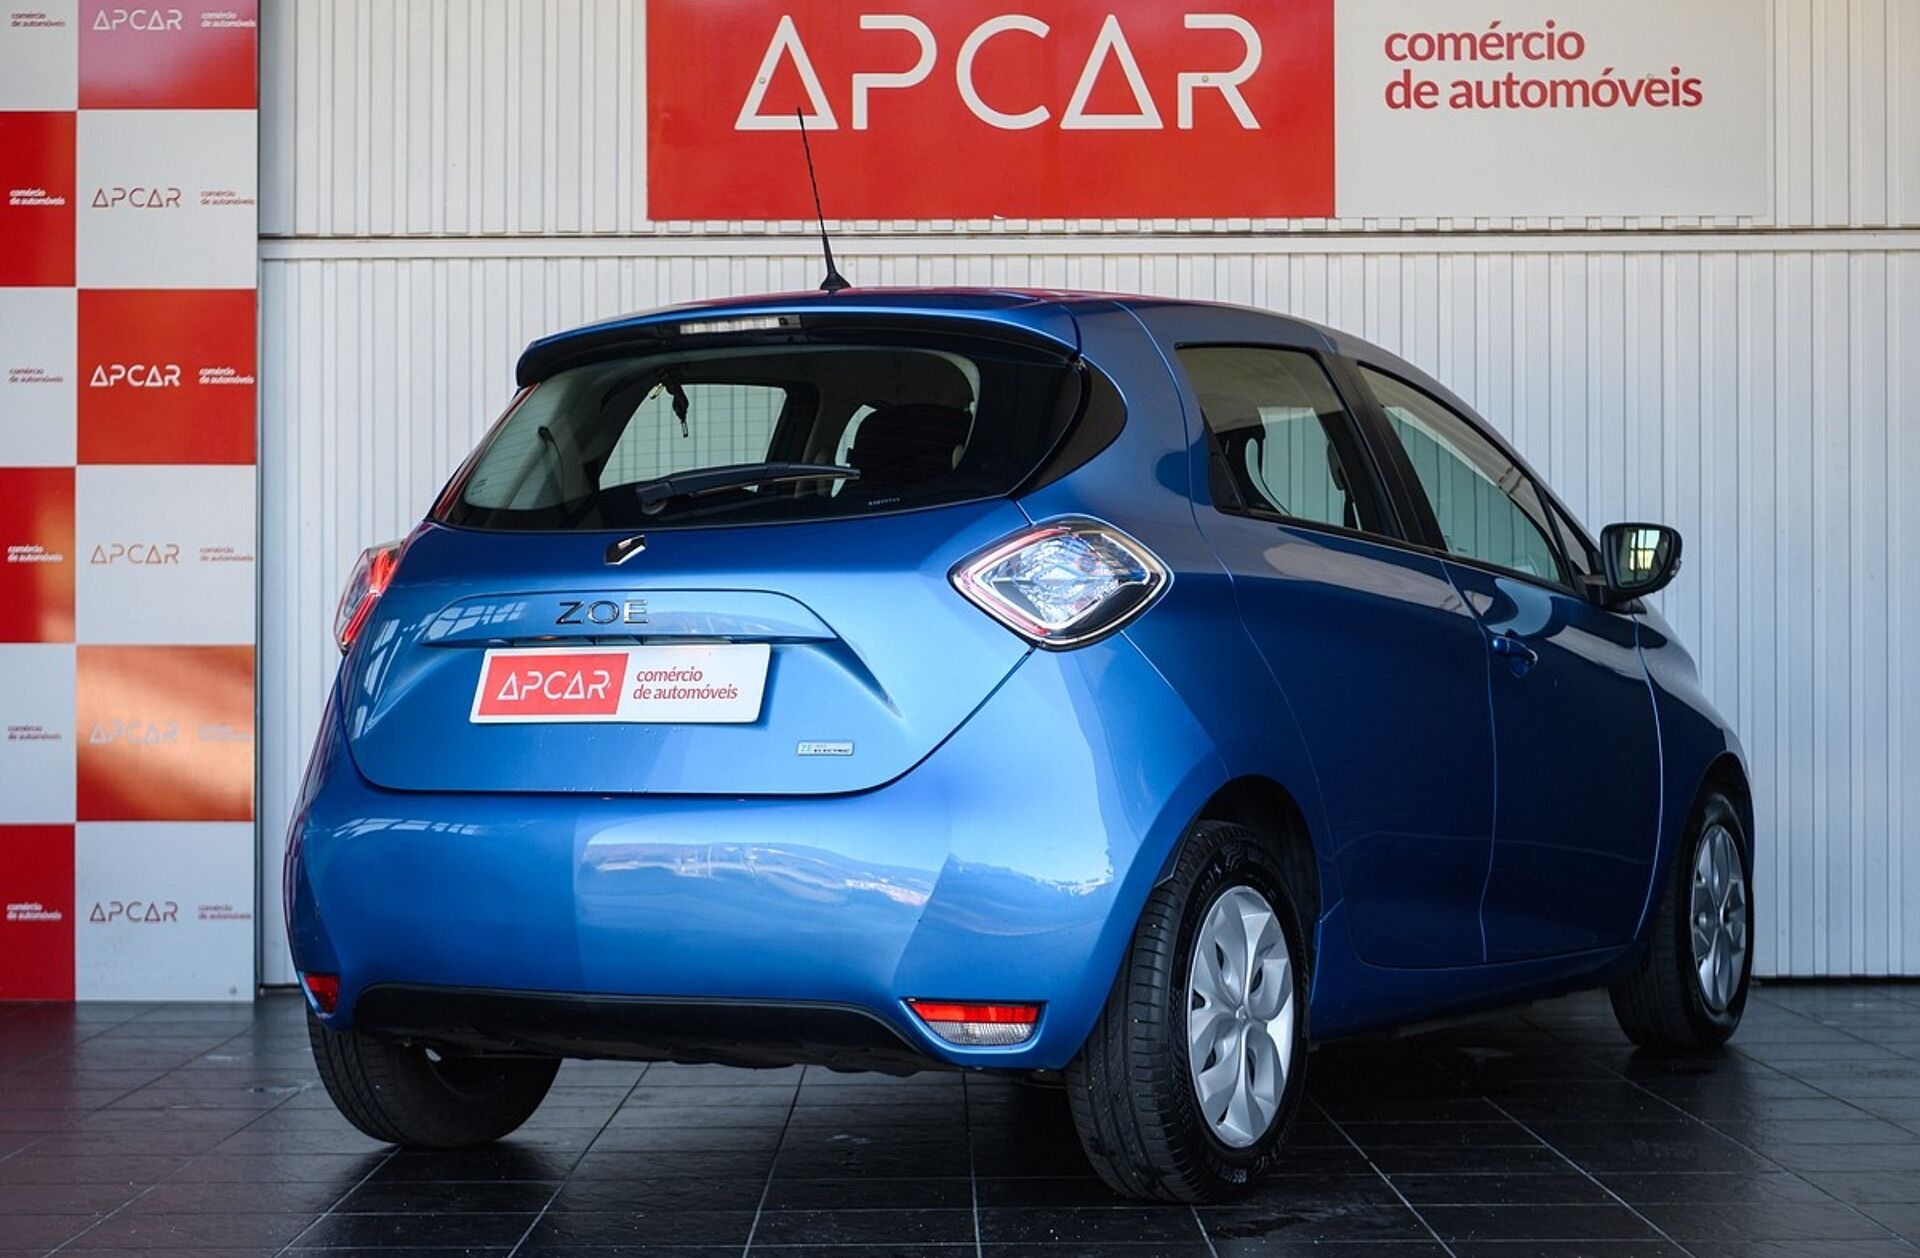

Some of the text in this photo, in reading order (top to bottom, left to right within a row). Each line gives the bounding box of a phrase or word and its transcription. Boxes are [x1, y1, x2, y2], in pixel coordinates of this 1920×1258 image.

[93, 9, 182, 30] APCAR
[1384, 20, 1585, 61] comércio
[734, 14, 1262, 130] APCAR
[1384, 66, 1704, 109] de automóveis
[92, 188, 181, 208] APCAR
[90, 365, 180, 387] APCAR
[90, 544, 179, 564] APCAR
[555, 600, 649, 625] ZOE
[497, 670, 611, 701] APCAR
[636, 667, 703, 683] comércio
[633, 683, 738, 700] de automóveis
[90, 901, 178, 922] APCAR
